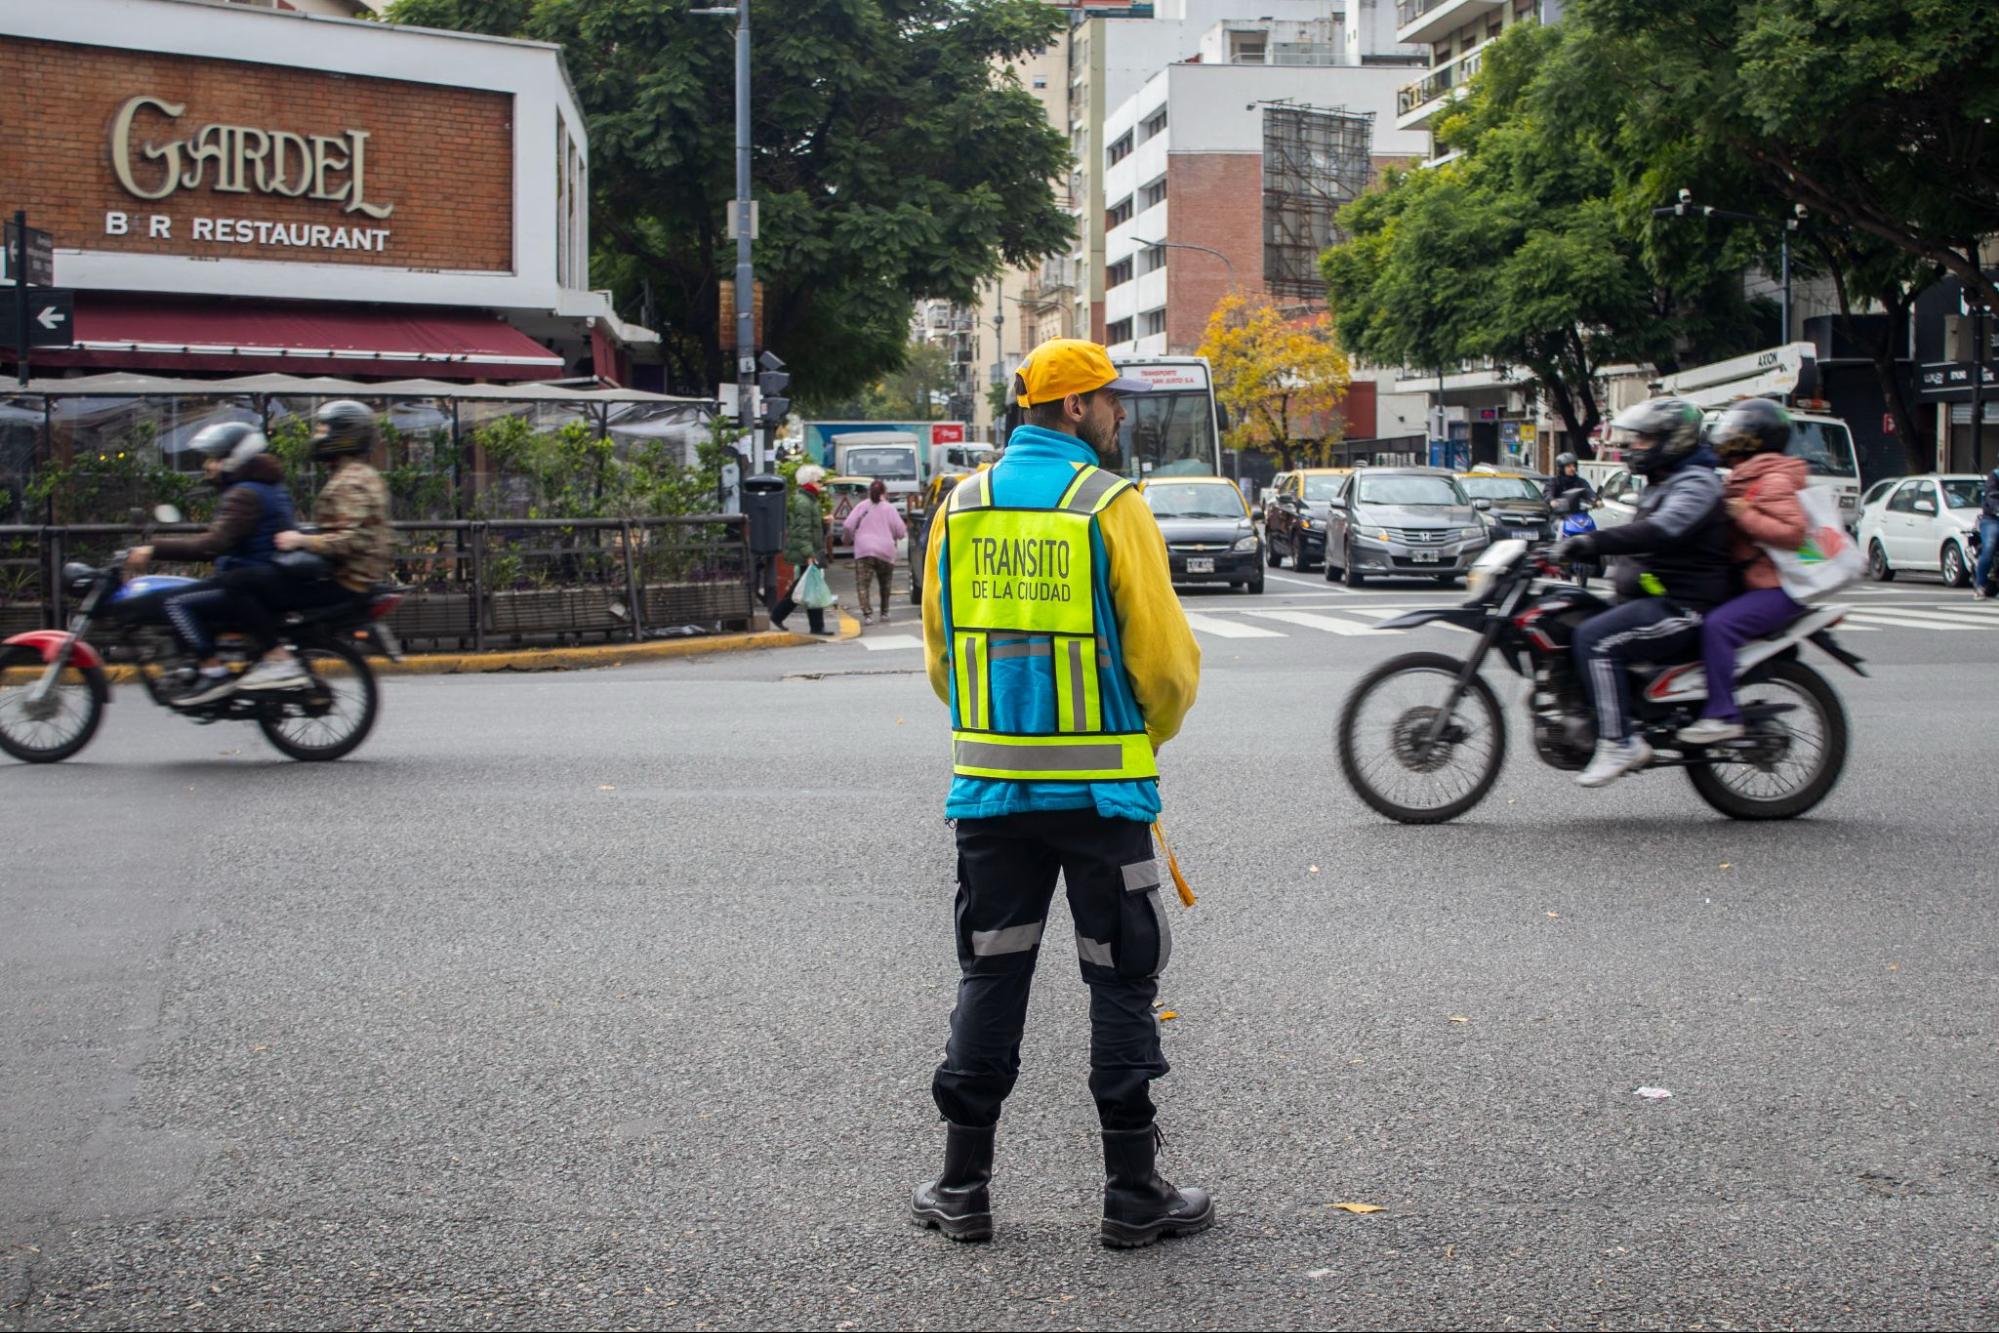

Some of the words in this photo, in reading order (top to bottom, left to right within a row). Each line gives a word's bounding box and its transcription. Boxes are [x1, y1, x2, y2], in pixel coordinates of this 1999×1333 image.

[112, 95, 394, 219] GARDEL
[105, 211, 172, 239] BR
[192, 217, 391, 252] RESTAURANT
[971, 537, 1070, 579] TRANSITO
[972, 580, 988, 599] DE
[993, 580, 1014, 600] LA
[1017, 582, 1071, 602] CIUDAD
